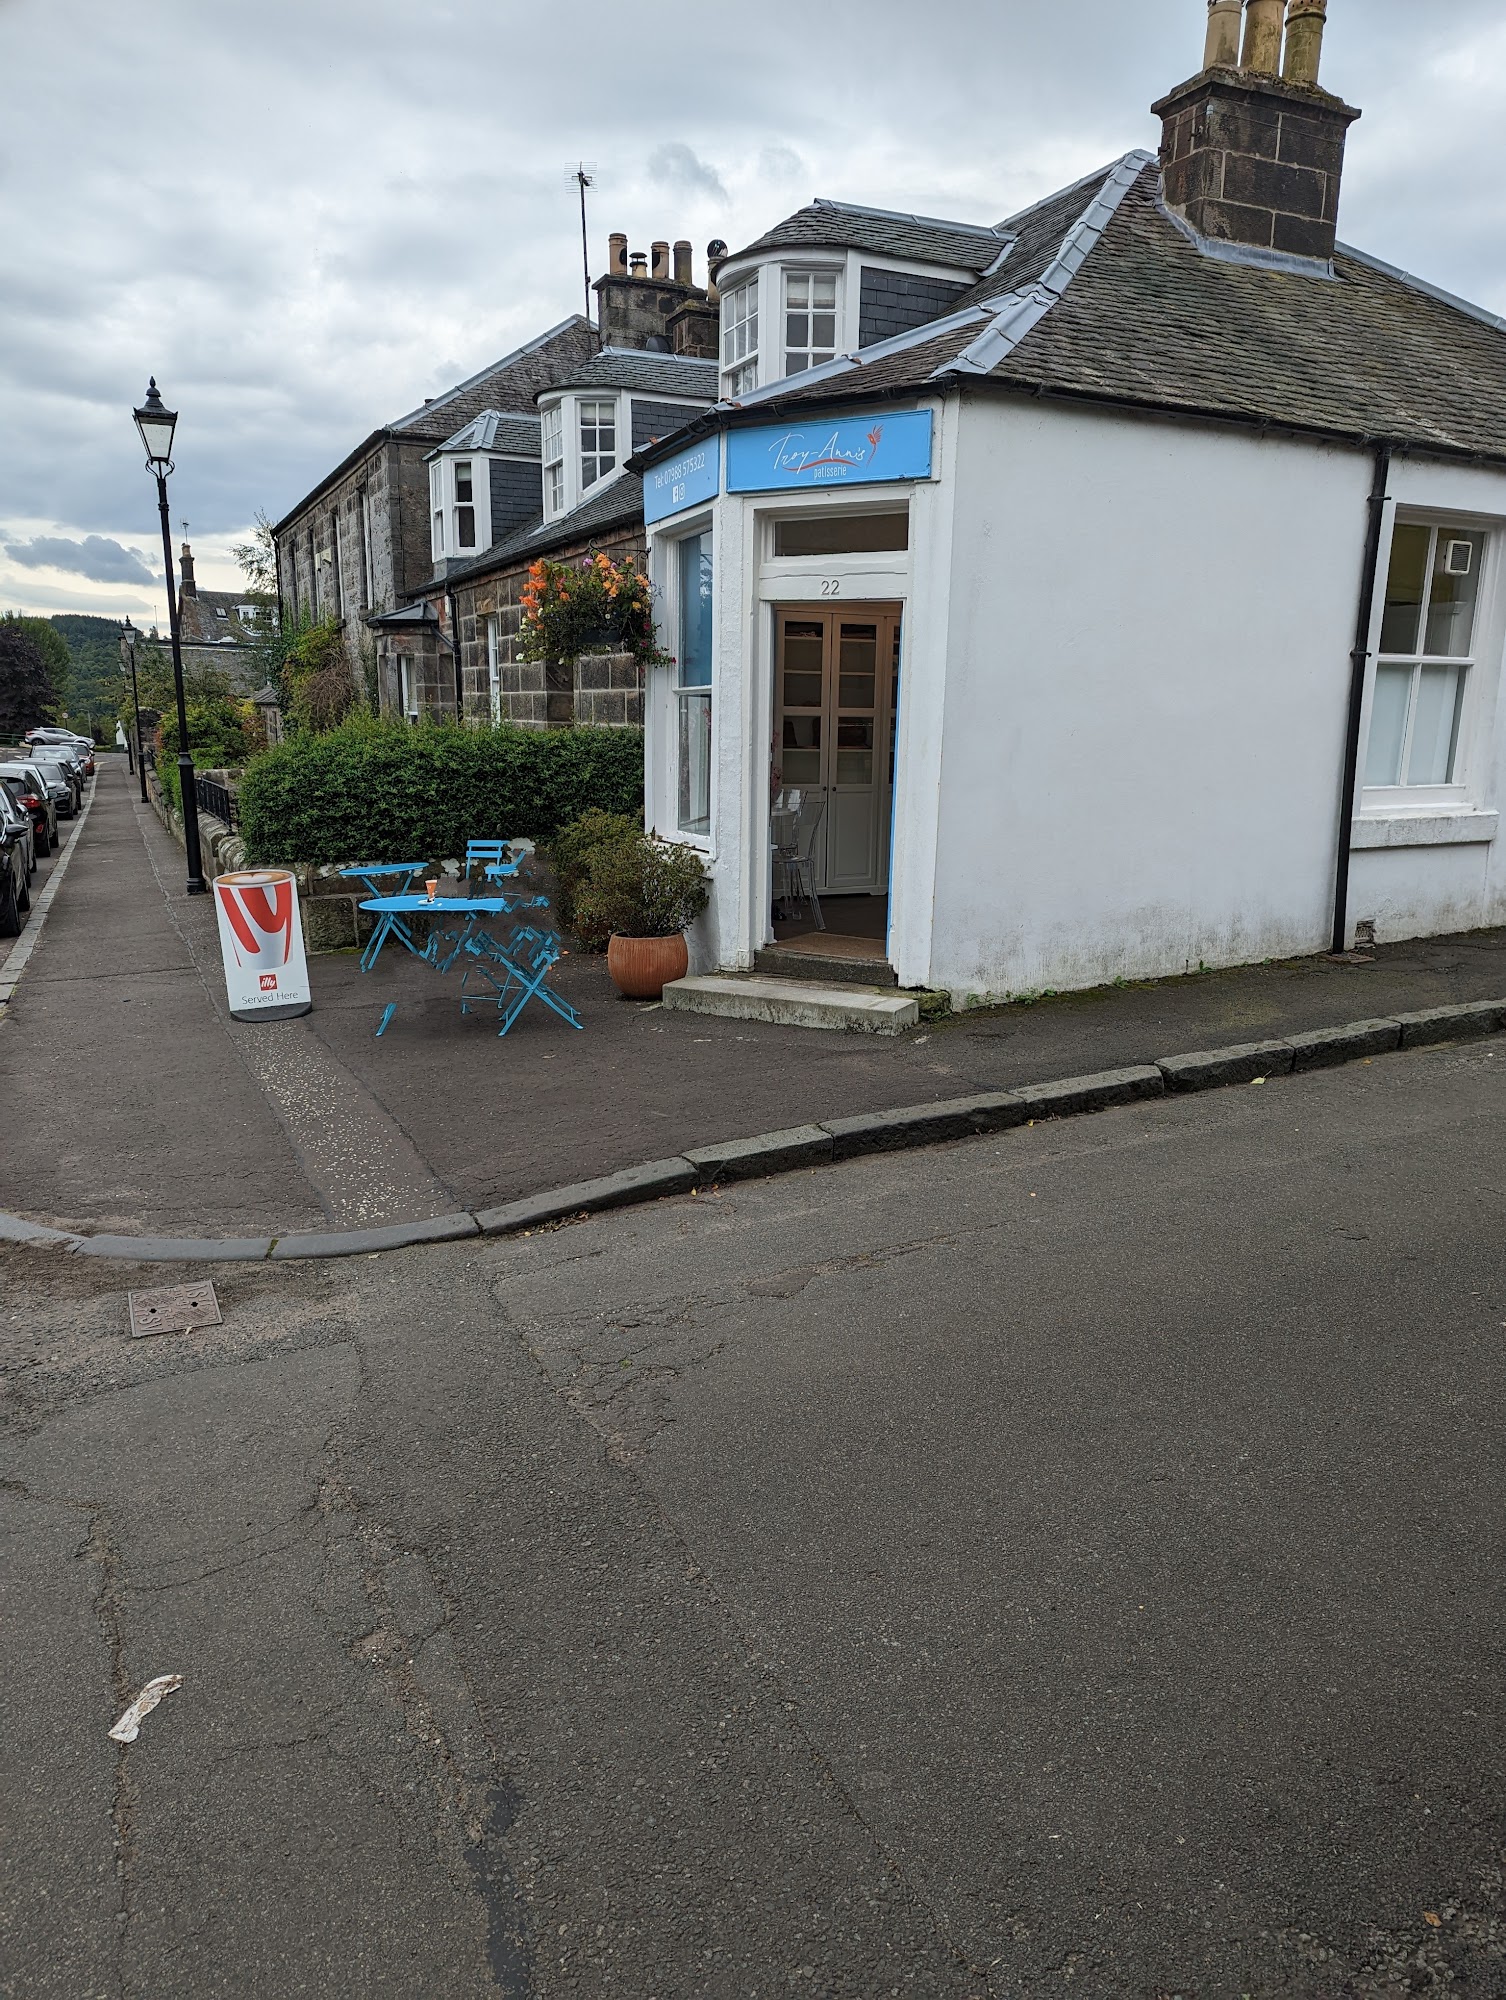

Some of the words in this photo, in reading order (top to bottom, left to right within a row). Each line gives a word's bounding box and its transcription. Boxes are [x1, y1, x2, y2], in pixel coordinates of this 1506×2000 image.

[768, 431, 866, 475] Troy-Ann's
[665, 464, 681, 485] 07988
[683, 453, 704, 476] 575322
[813, 465, 847, 480] patisserie
[821, 579, 840, 596] 22
[262, 977, 275, 989] illy
[242, 993, 273, 1004] Served
[277, 992, 298, 1000] Here
